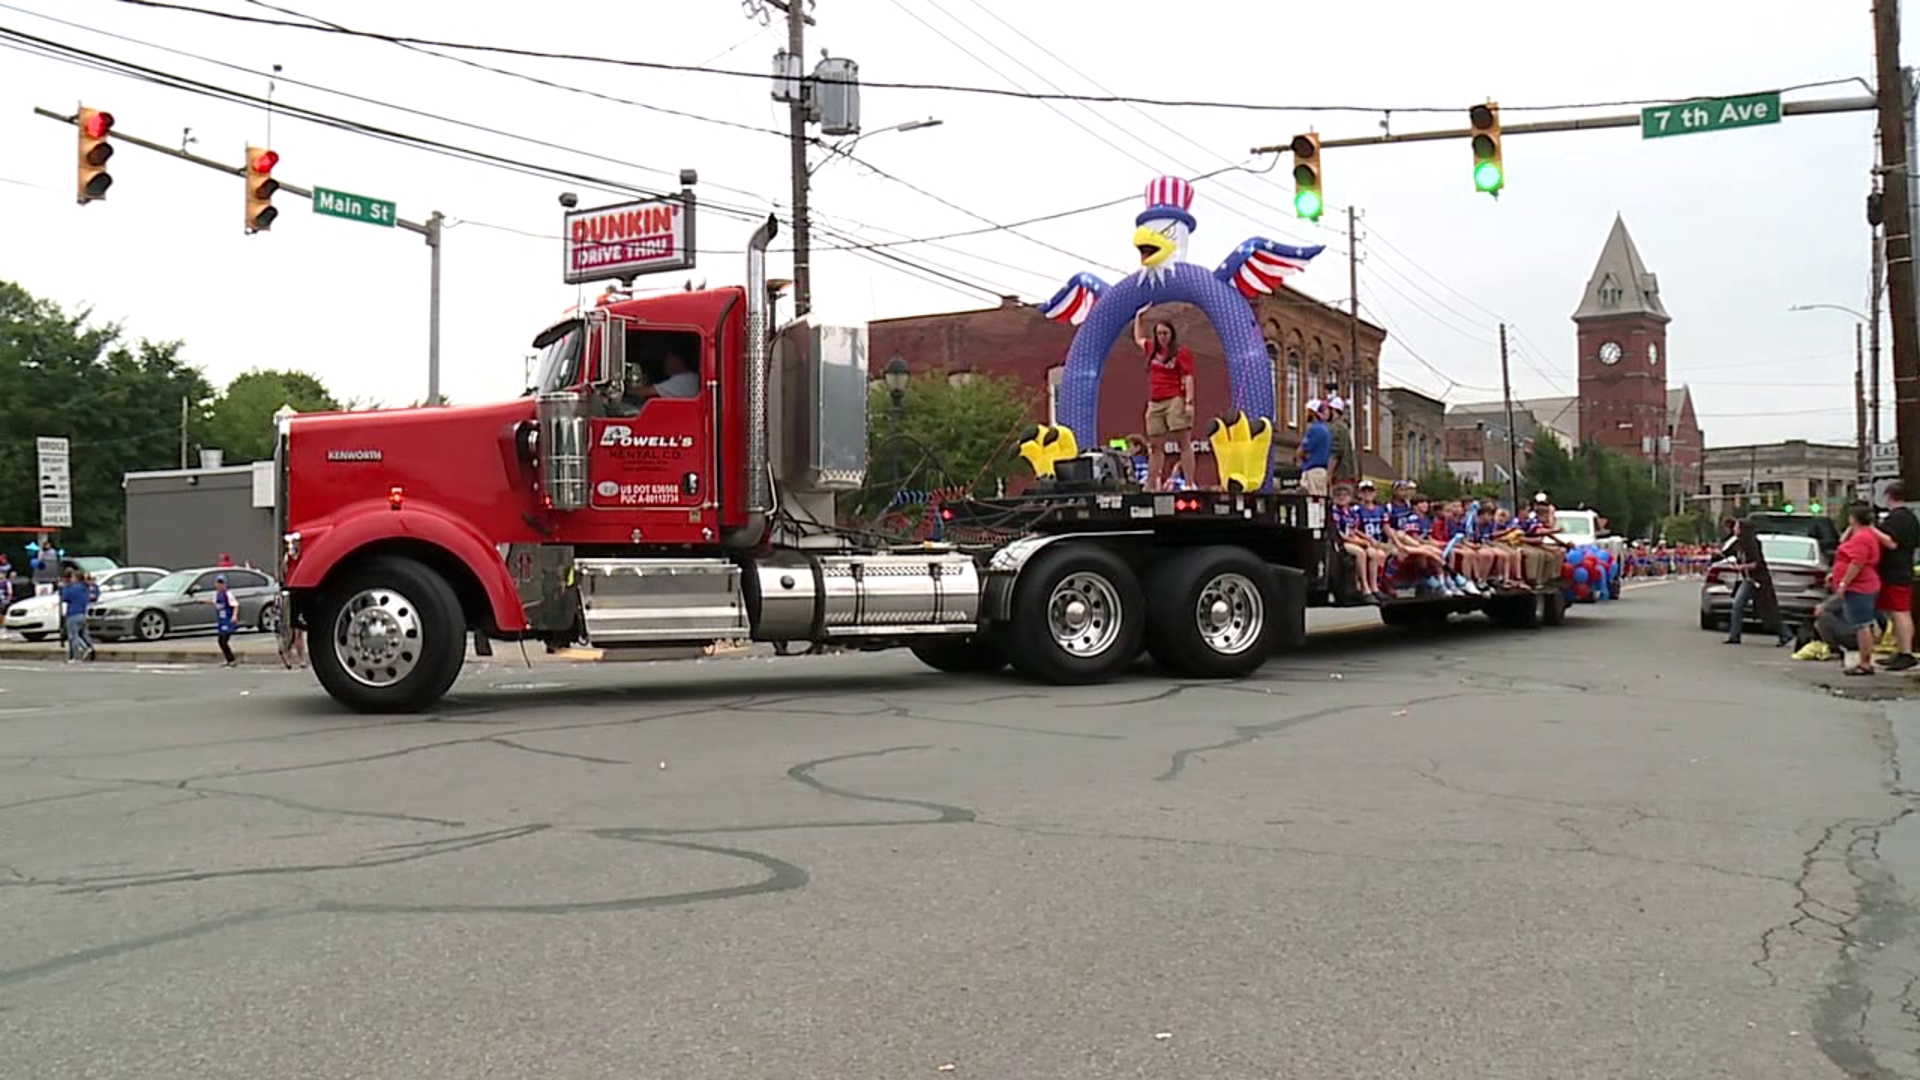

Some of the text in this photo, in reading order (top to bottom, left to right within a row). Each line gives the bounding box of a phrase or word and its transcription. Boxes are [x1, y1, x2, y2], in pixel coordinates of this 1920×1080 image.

[1653, 102, 1768, 131] 7 th Ave
[320, 191, 389, 221] Main St
[572, 204, 679, 246] DUNKIN'
[579, 238, 667, 265] DRIVE THRU
[327, 450, 382, 460] KENWORTH
[1164, 440, 1211, 453] BLCK
